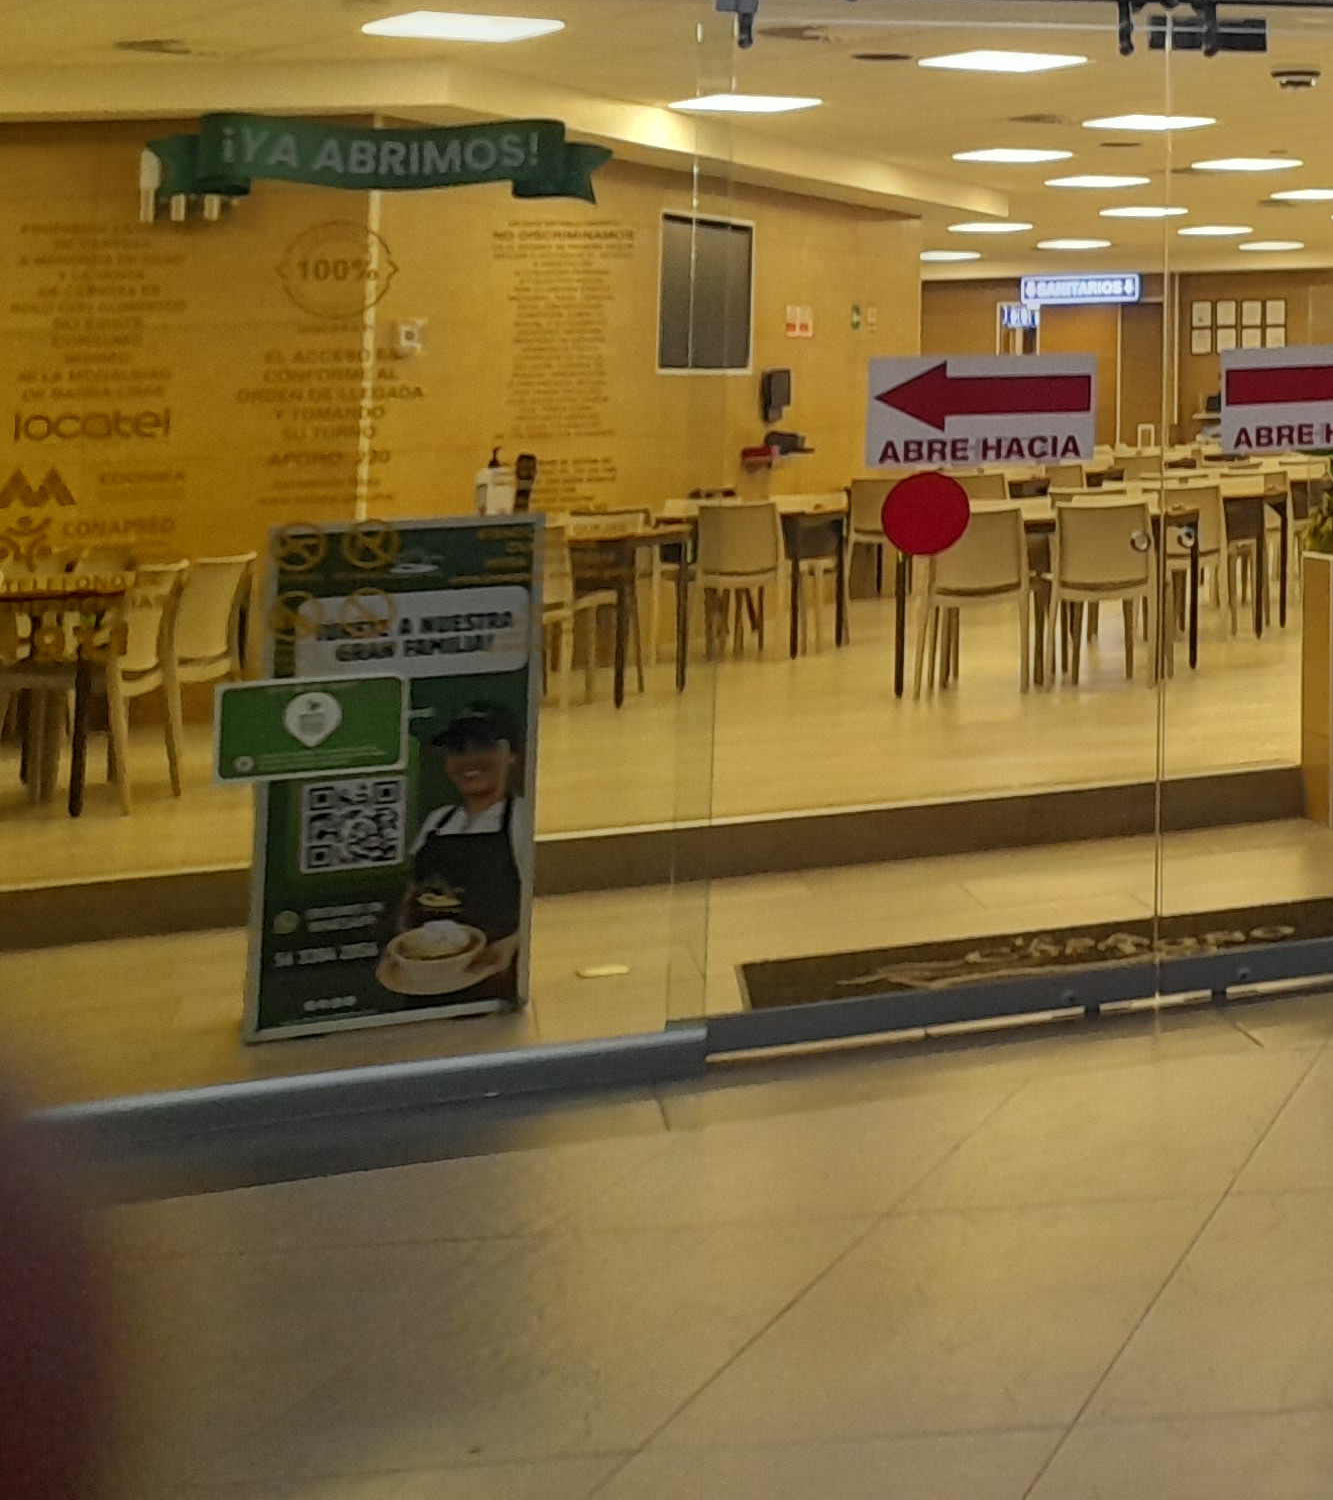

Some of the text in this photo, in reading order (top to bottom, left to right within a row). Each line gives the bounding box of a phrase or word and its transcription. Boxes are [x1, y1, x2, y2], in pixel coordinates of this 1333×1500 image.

[221, 126, 540, 177] ¡YA ABRIMOS!
[297, 257, 379, 282] 100%
[1036, 279, 1122, 299] SANITARIOS
[13, 407, 171, 442] locatel
[1233, 423, 1314, 450] ABRE
[879, 434, 1081, 465] ABRE HACIA
